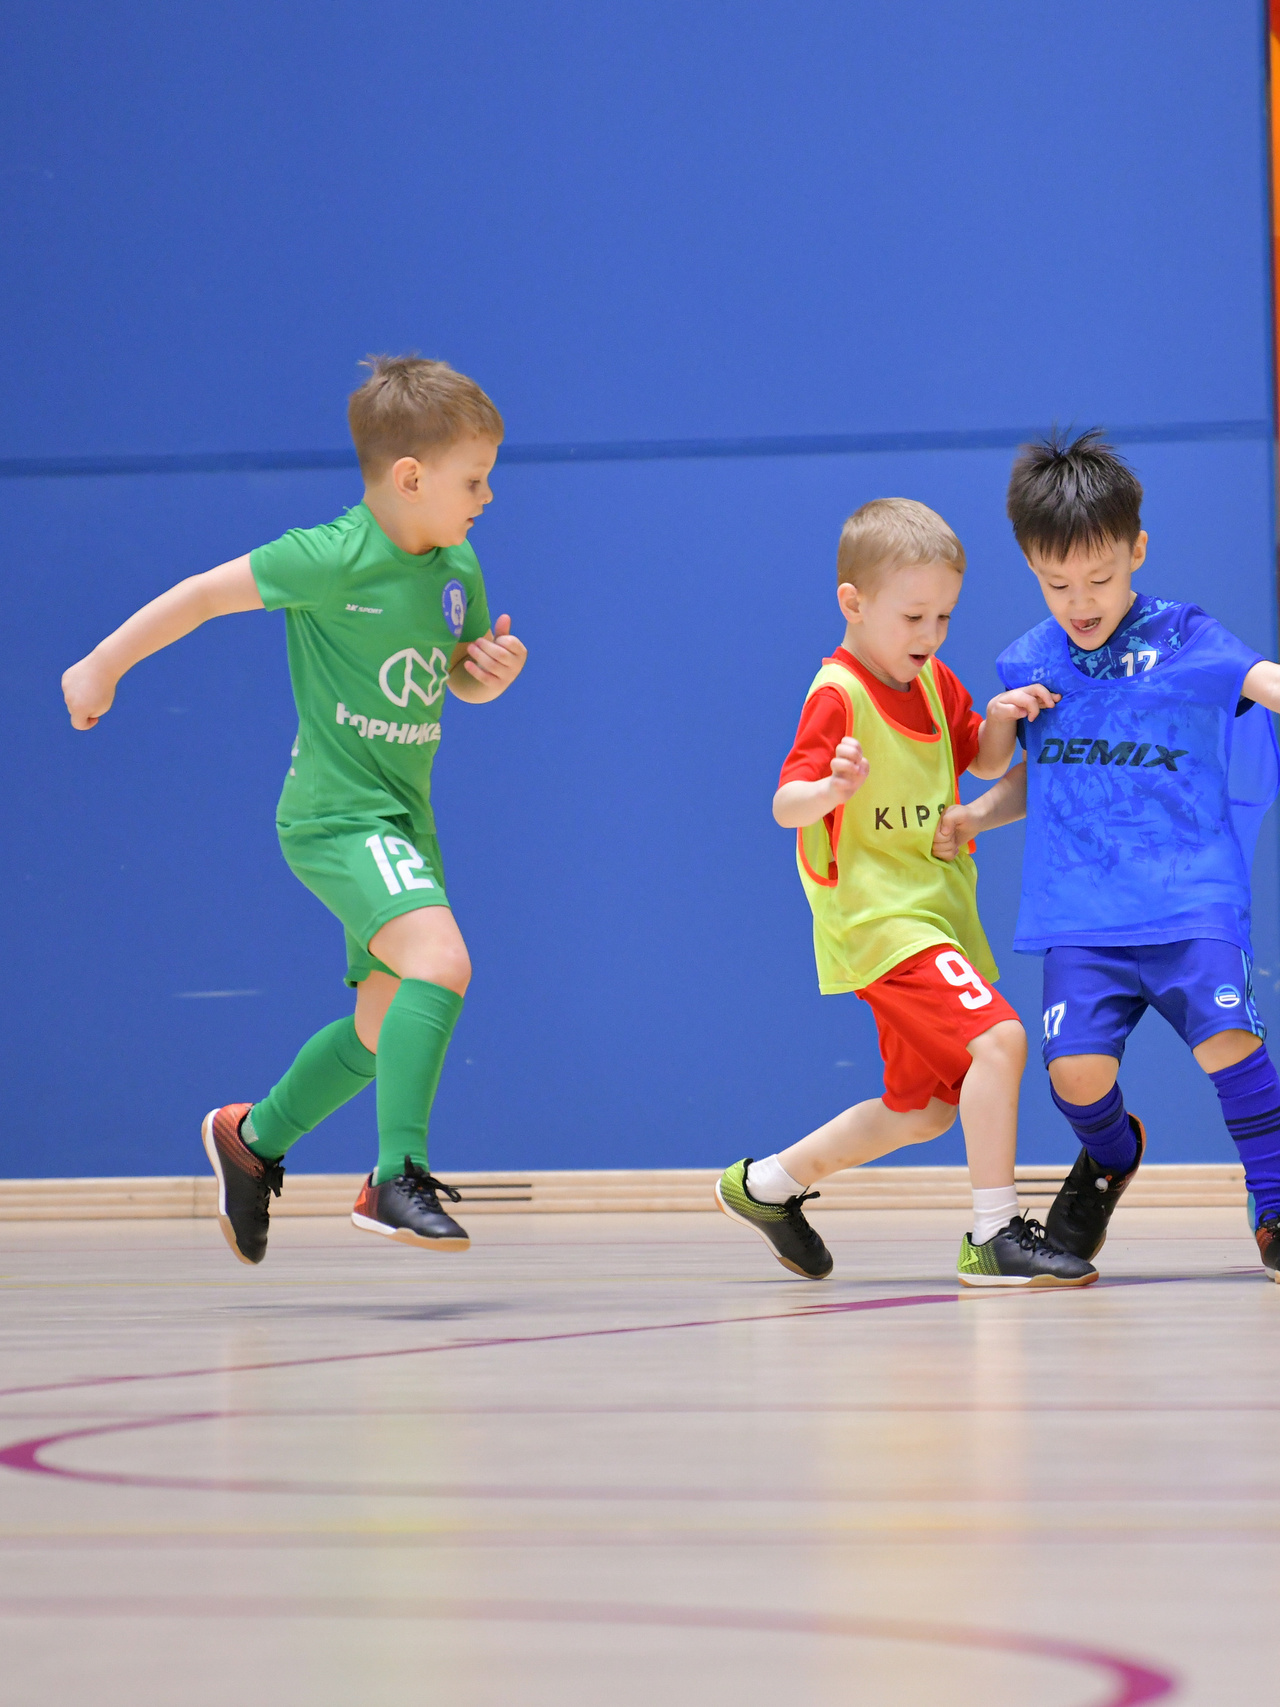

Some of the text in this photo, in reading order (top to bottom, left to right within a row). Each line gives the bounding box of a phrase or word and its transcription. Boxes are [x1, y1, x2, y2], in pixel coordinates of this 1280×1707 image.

[1120, 650, 1158, 678] 17
[1037, 738, 1190, 772] DEMIX
[365, 834, 435, 896] 12
[935, 951, 993, 1010] 9
[1042, 1001, 1067, 1042] 17
